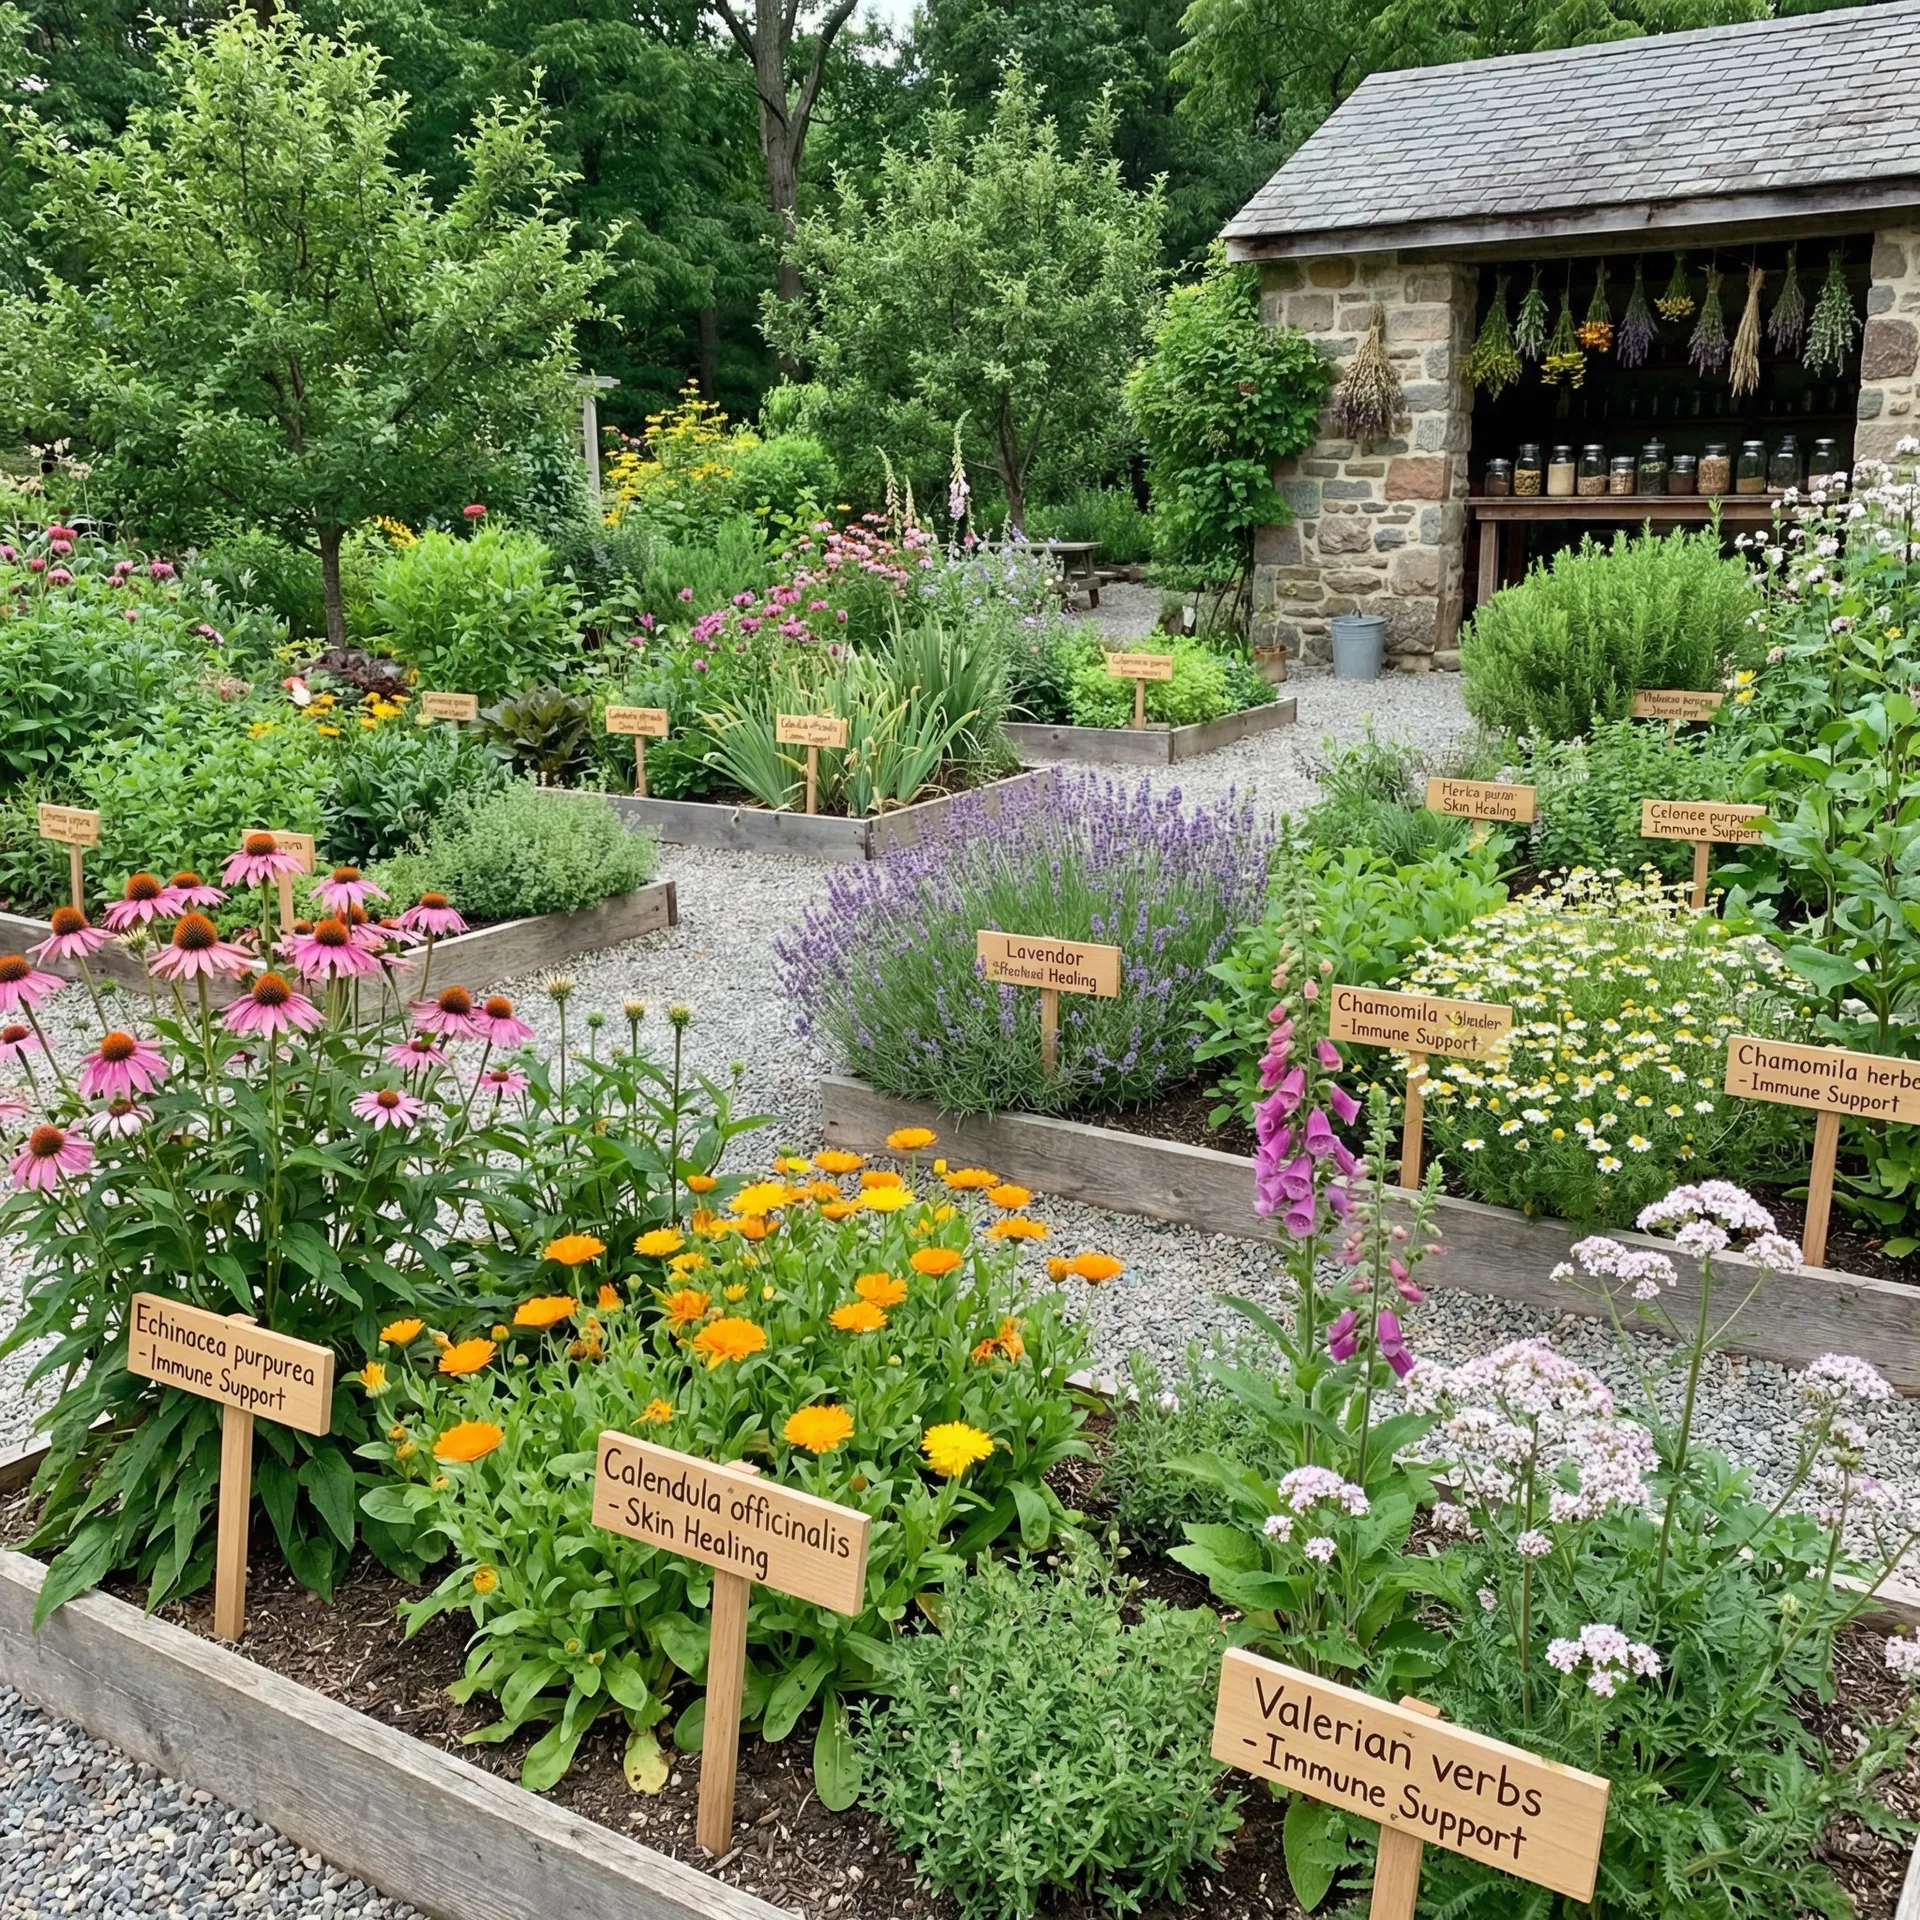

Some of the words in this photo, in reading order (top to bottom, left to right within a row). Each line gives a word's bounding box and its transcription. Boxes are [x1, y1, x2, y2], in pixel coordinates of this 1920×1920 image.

[1443, 798, 1469, 813] Skin
[1007, 940, 1084, 966] Lavendor
[1049, 968, 1097, 993] Healing
[1338, 992, 1438, 1023] Chamomila
[1416, 1027, 1478, 1052] Support
[1738, 1044, 1857, 1081] Chamomila
[1827, 1085, 1900, 1113] Support
[137, 1303, 226, 1357] Echinacea
[234, 1344, 314, 1386] purpurea
[219, 1368, 286, 1411] Support
[604, 1448, 721, 1514] Calendula
[730, 1493, 850, 1558] officinalis
[684, 1515, 769, 1581] Healing
[1254, 1676, 1411, 1770] Valerian
[1432, 1754, 1542, 1817] verbs
[1399, 1784, 1527, 1860] Support
